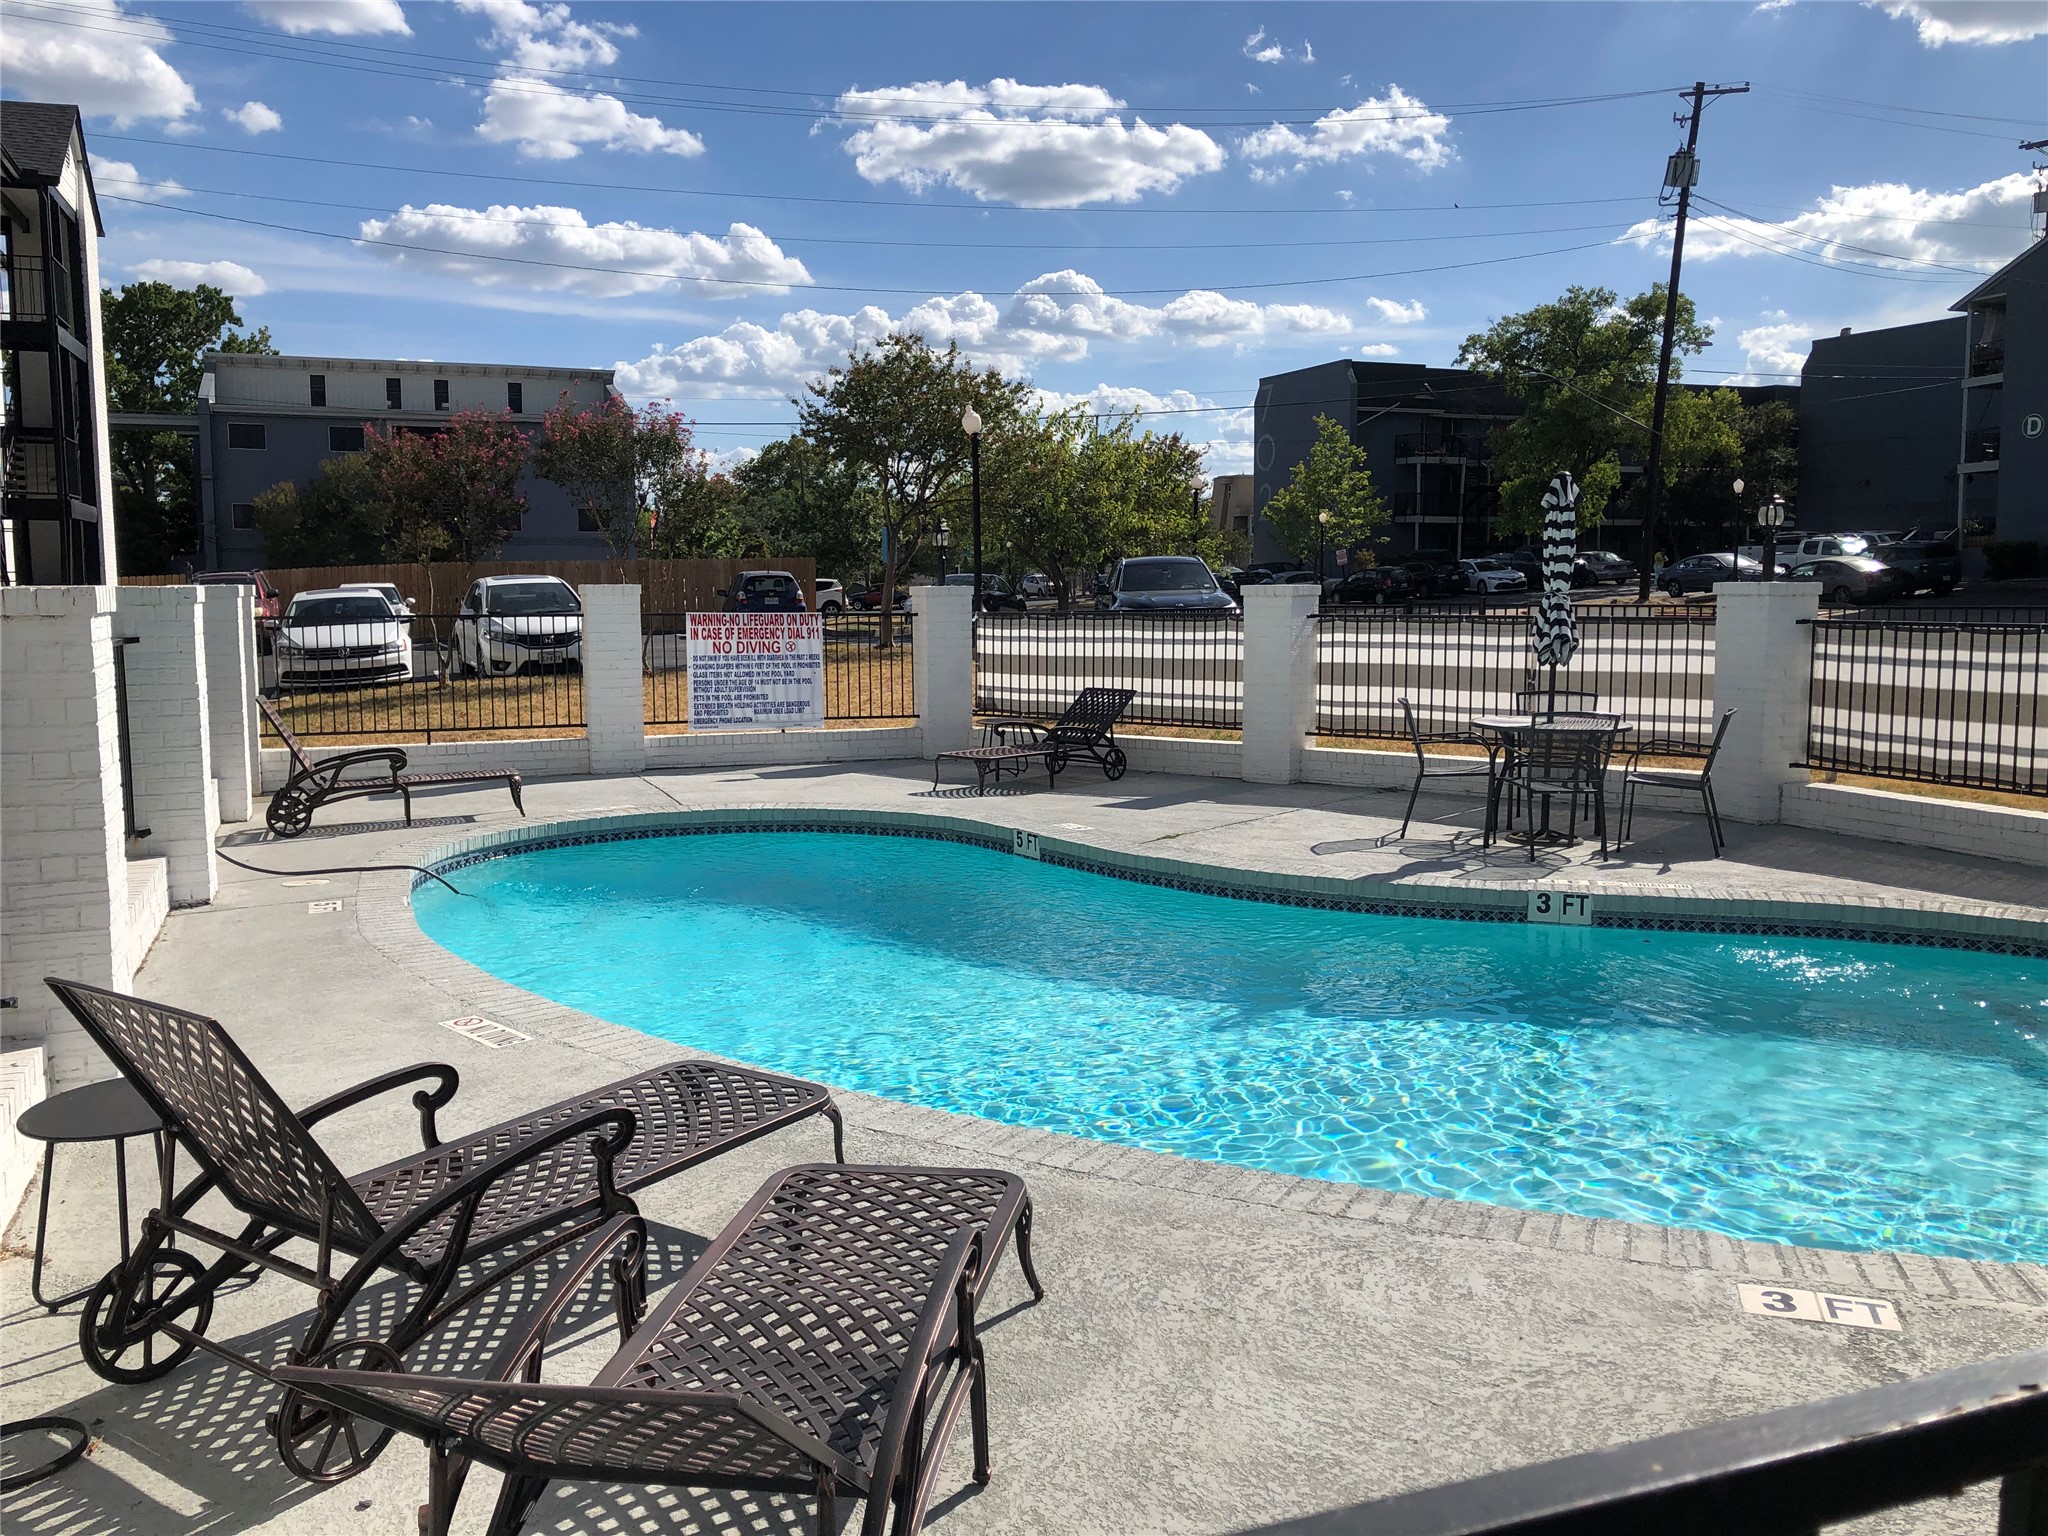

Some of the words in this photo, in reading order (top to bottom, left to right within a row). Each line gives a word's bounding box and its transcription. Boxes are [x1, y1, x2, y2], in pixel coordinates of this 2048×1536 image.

[2027, 416, 2042, 435] D
[690, 613, 740, 626] WARNING-NO
[743, 613, 785, 626] LIFEGUARD
[787, 613, 797, 626] ON
[800, 613, 819, 626] DUTY
[690, 627, 699, 640] IN
[702, 627, 722, 640] CASE
[725, 627, 735, 640] OF
[737, 627, 785, 640] EMERGENCY
[788, 627, 805, 640] DIAL
[807, 627, 820, 639] 911
[713, 641, 732, 654] NO
[737, 641, 781, 654] DIVING
[1016, 831, 1023, 848] 5
[1027, 833, 1038, 852] FT
[1536, 892, 1551, 914] 3
[1562, 894, 1589, 916] FT
[1760, 1290, 1797, 1313] 3
[1824, 1297, 1888, 1325] FT
